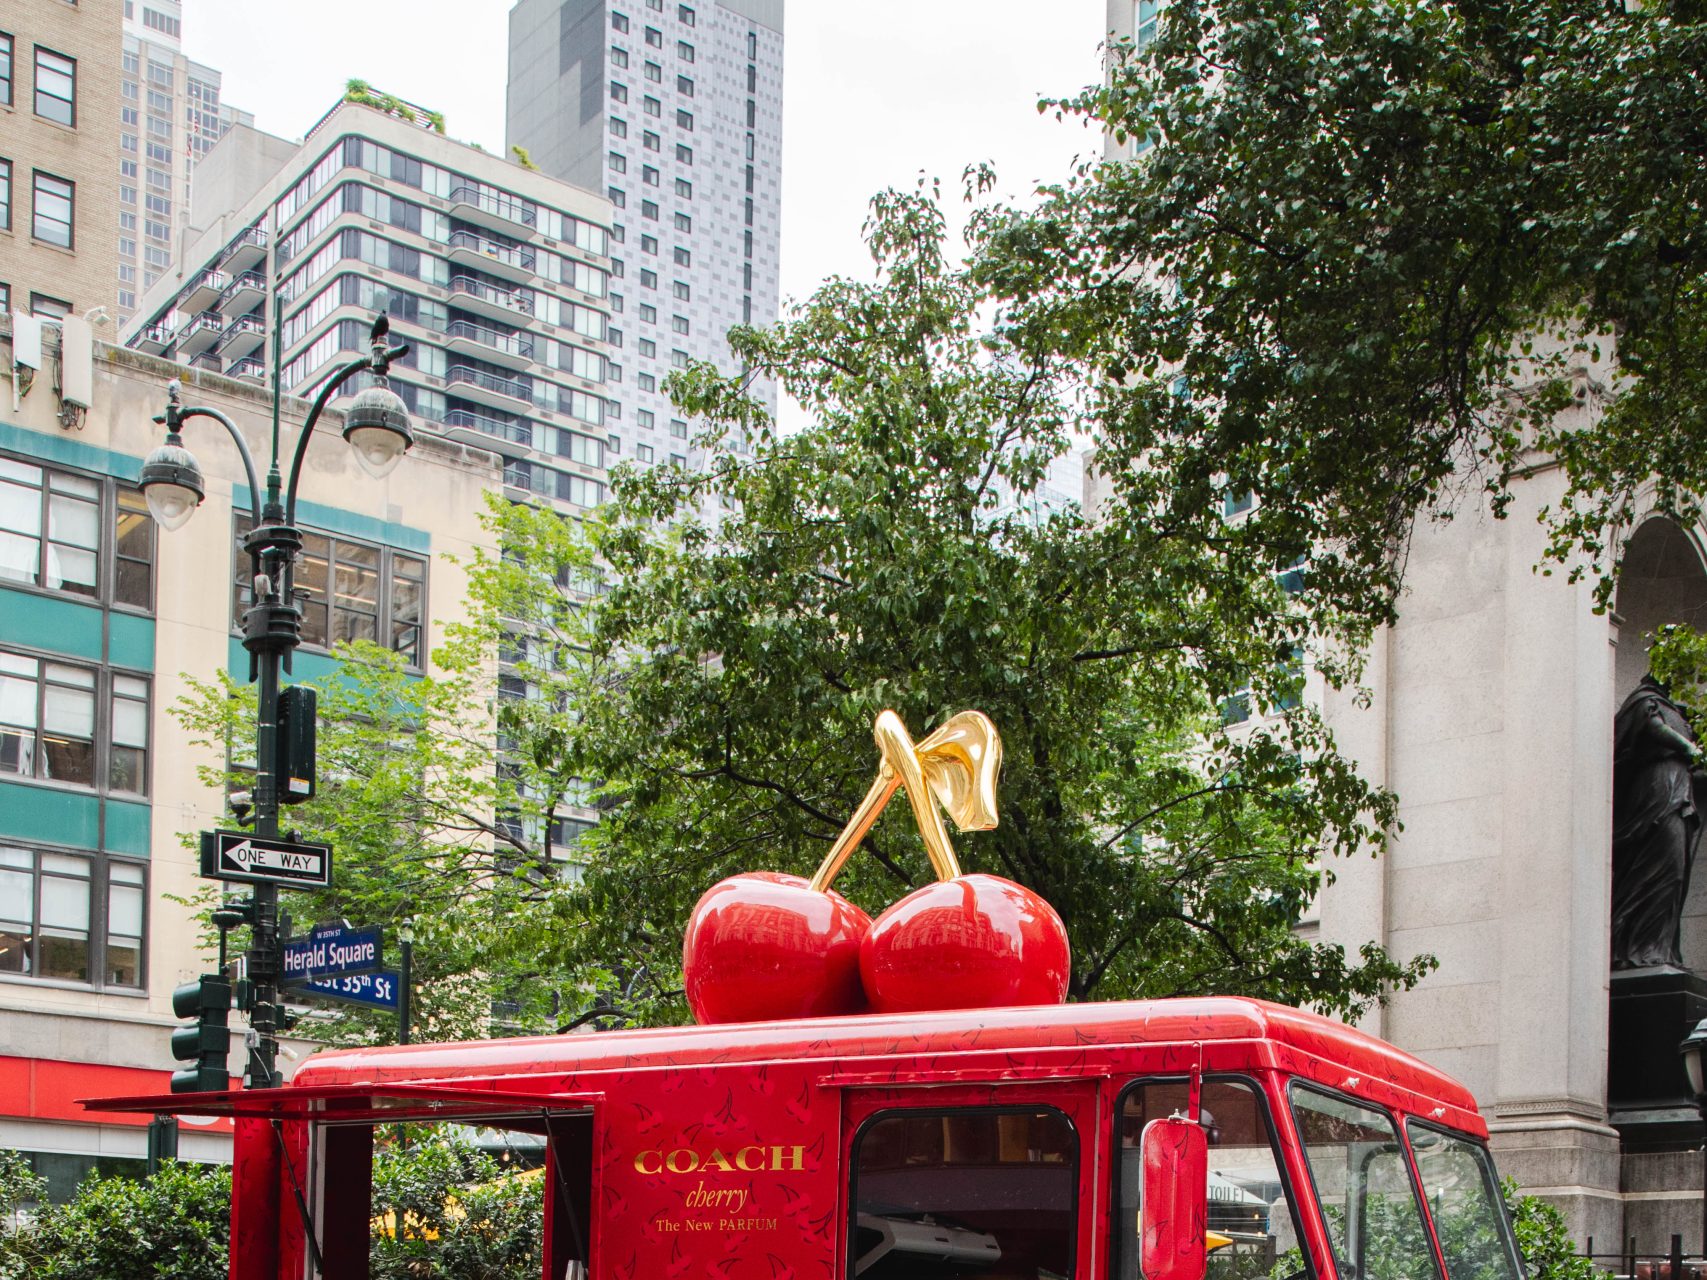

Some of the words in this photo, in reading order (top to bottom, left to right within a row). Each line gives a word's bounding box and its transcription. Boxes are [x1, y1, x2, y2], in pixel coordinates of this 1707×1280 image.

[237, 848, 266, 865] ONE
[281, 853, 312, 870] WAY
[316, 931, 323, 940] W
[323, 929, 335, 939] 35TH
[335, 928, 342, 937] ST
[284, 943, 326, 972] Herald
[329, 942, 375, 970] Square
[375, 977, 391, 1001] St
[634, 1145, 806, 1175] COACH
[685, 1180, 748, 1214] cherry
[656, 1219, 680, 1232] The
[685, 1219, 714, 1231] New
[719, 1218, 777, 1231] PARFUM
